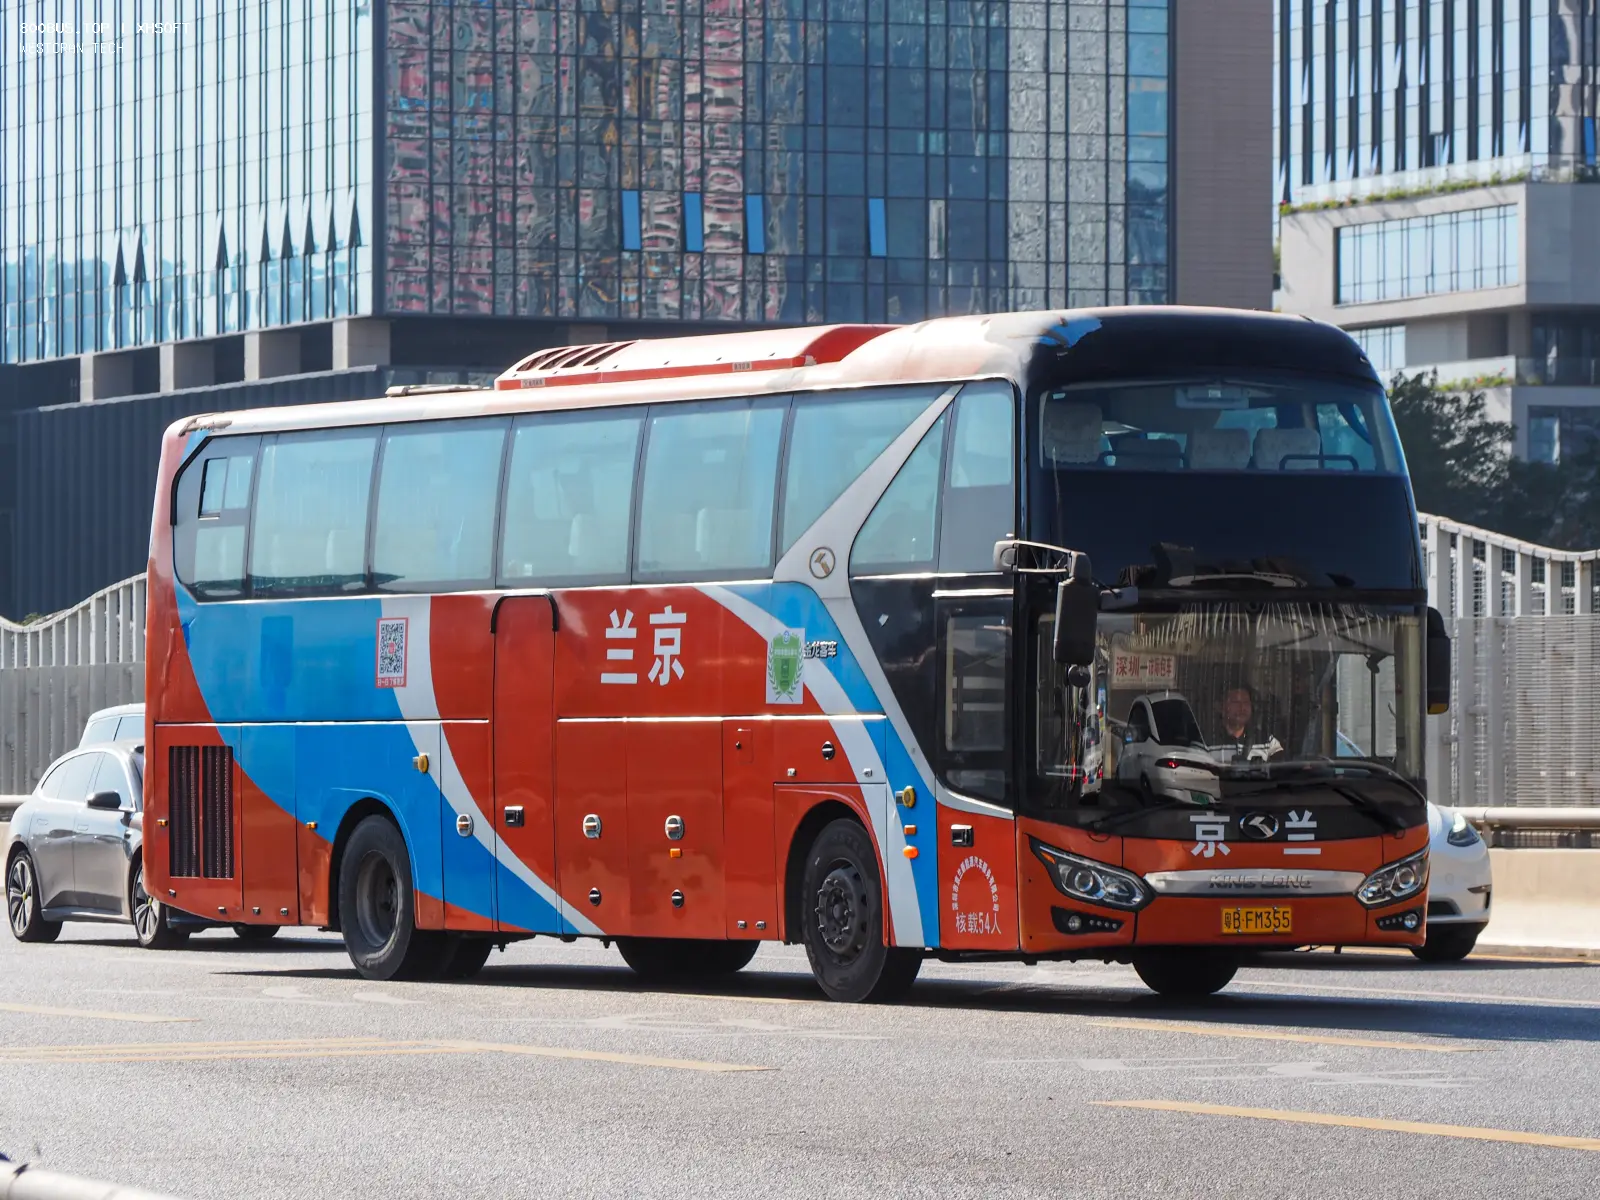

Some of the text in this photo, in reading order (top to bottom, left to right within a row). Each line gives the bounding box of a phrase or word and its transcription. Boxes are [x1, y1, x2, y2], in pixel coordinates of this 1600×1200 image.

[803, 641, 837, 659] 金龙客车
[1189, 810, 1321, 858] 京 兰
[1208, 874, 1313, 889] KING LONG
[955, 911, 1002, 935] 核载54人
